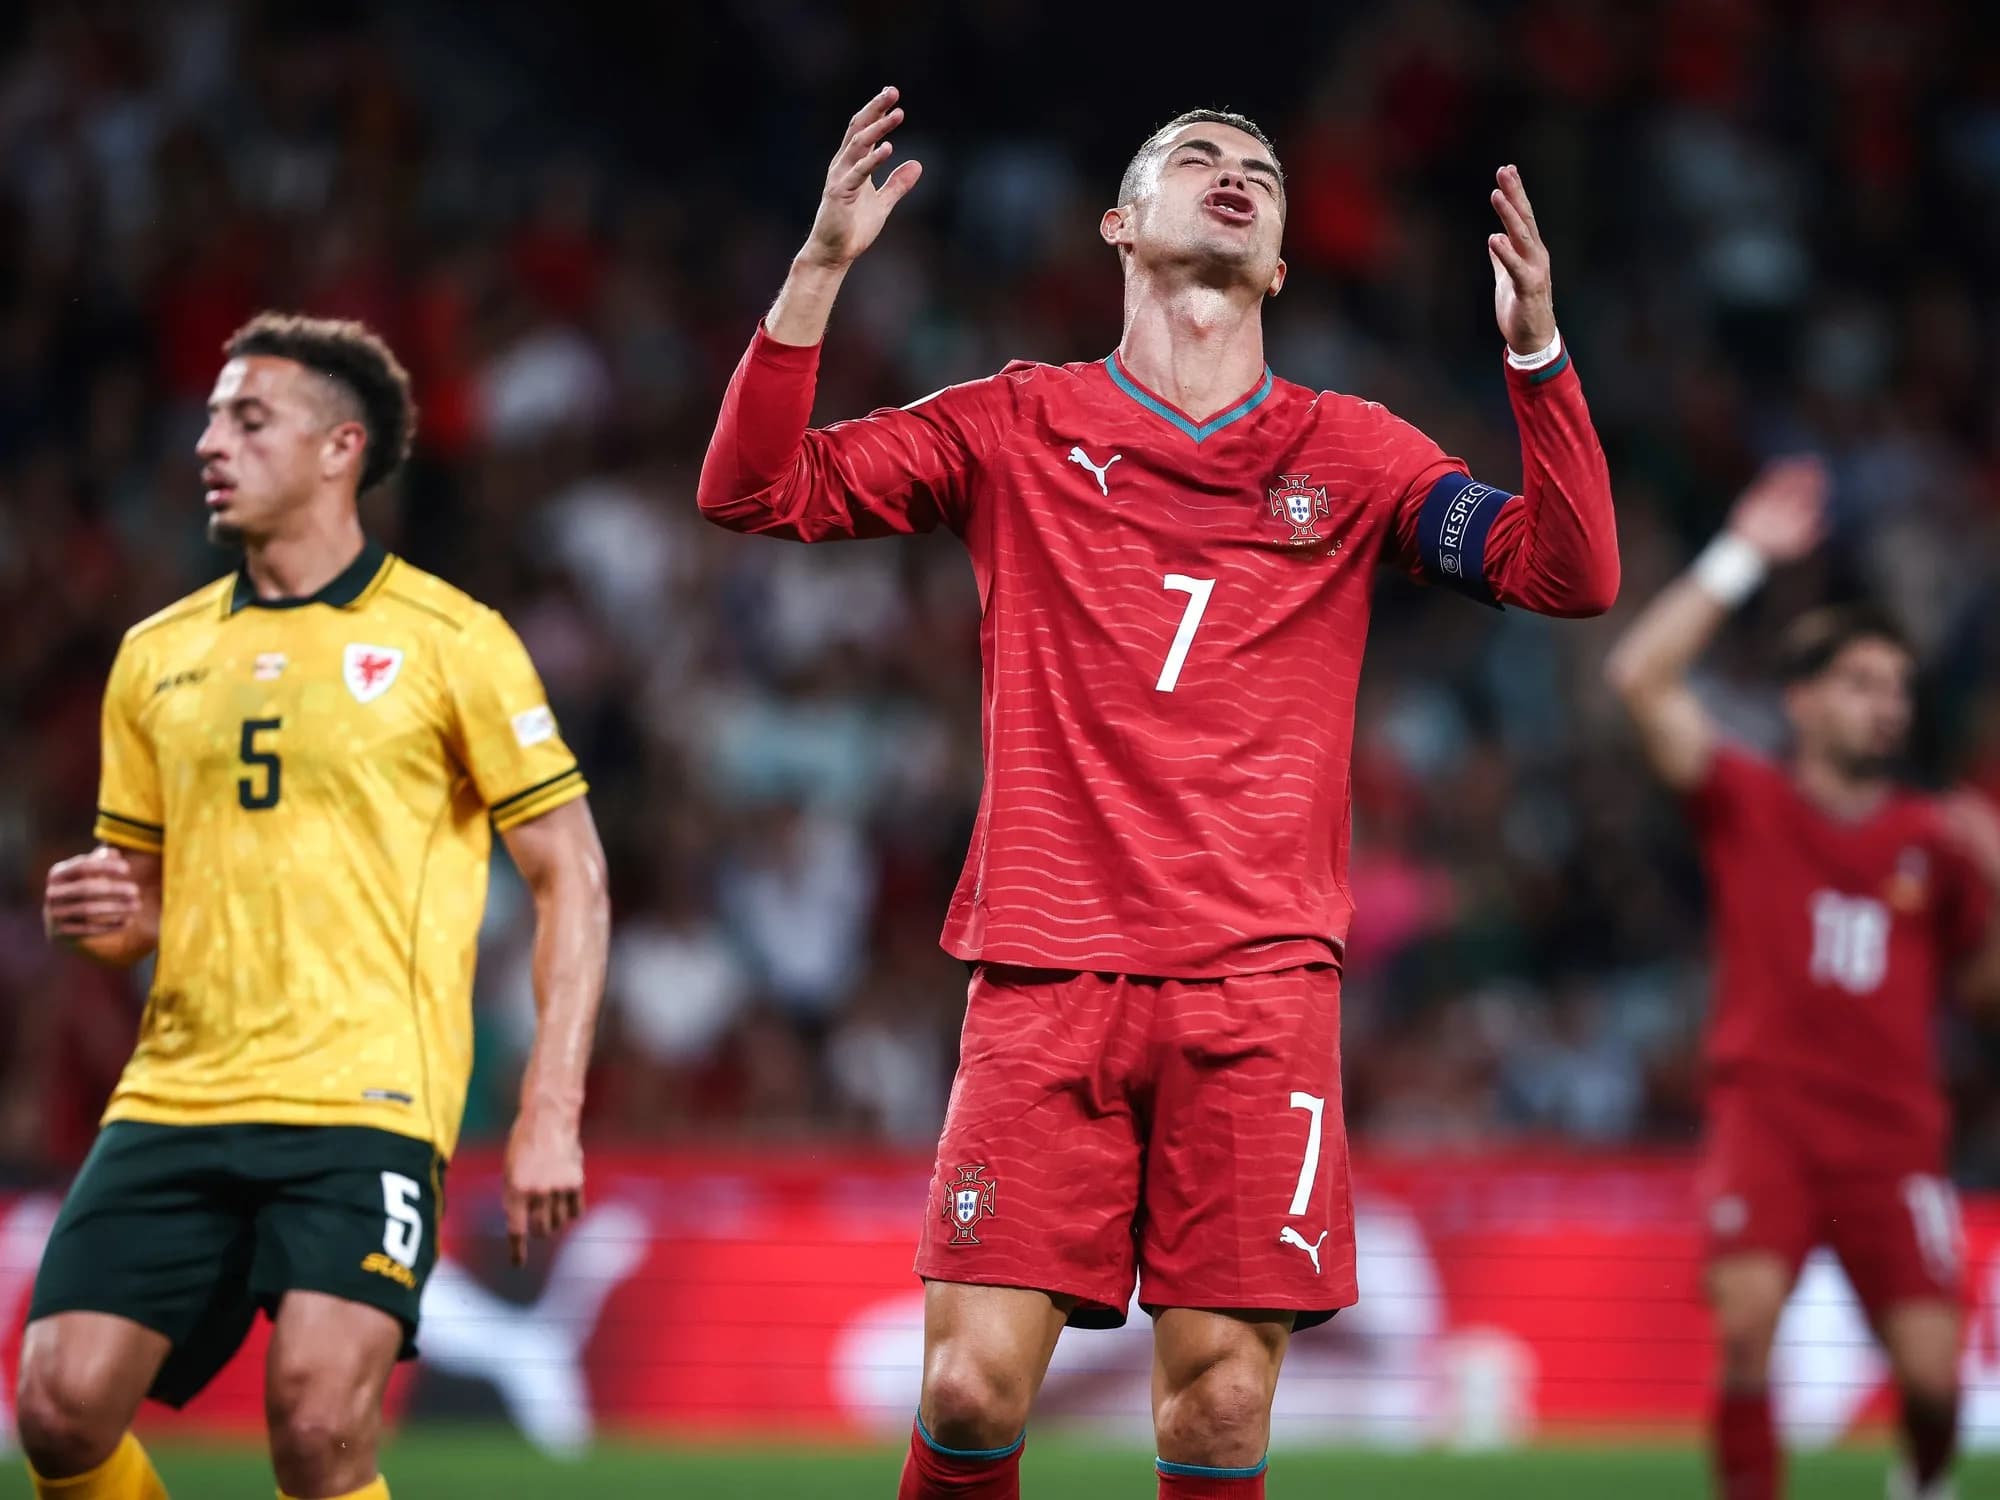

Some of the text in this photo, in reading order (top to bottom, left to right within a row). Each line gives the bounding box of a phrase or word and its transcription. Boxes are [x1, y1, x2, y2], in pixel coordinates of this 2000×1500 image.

[1154, 573, 1217, 694] 7
[237, 716, 282, 811] 5
[1288, 1091, 1325, 1216] 7
[380, 1169, 423, 1270] 5
